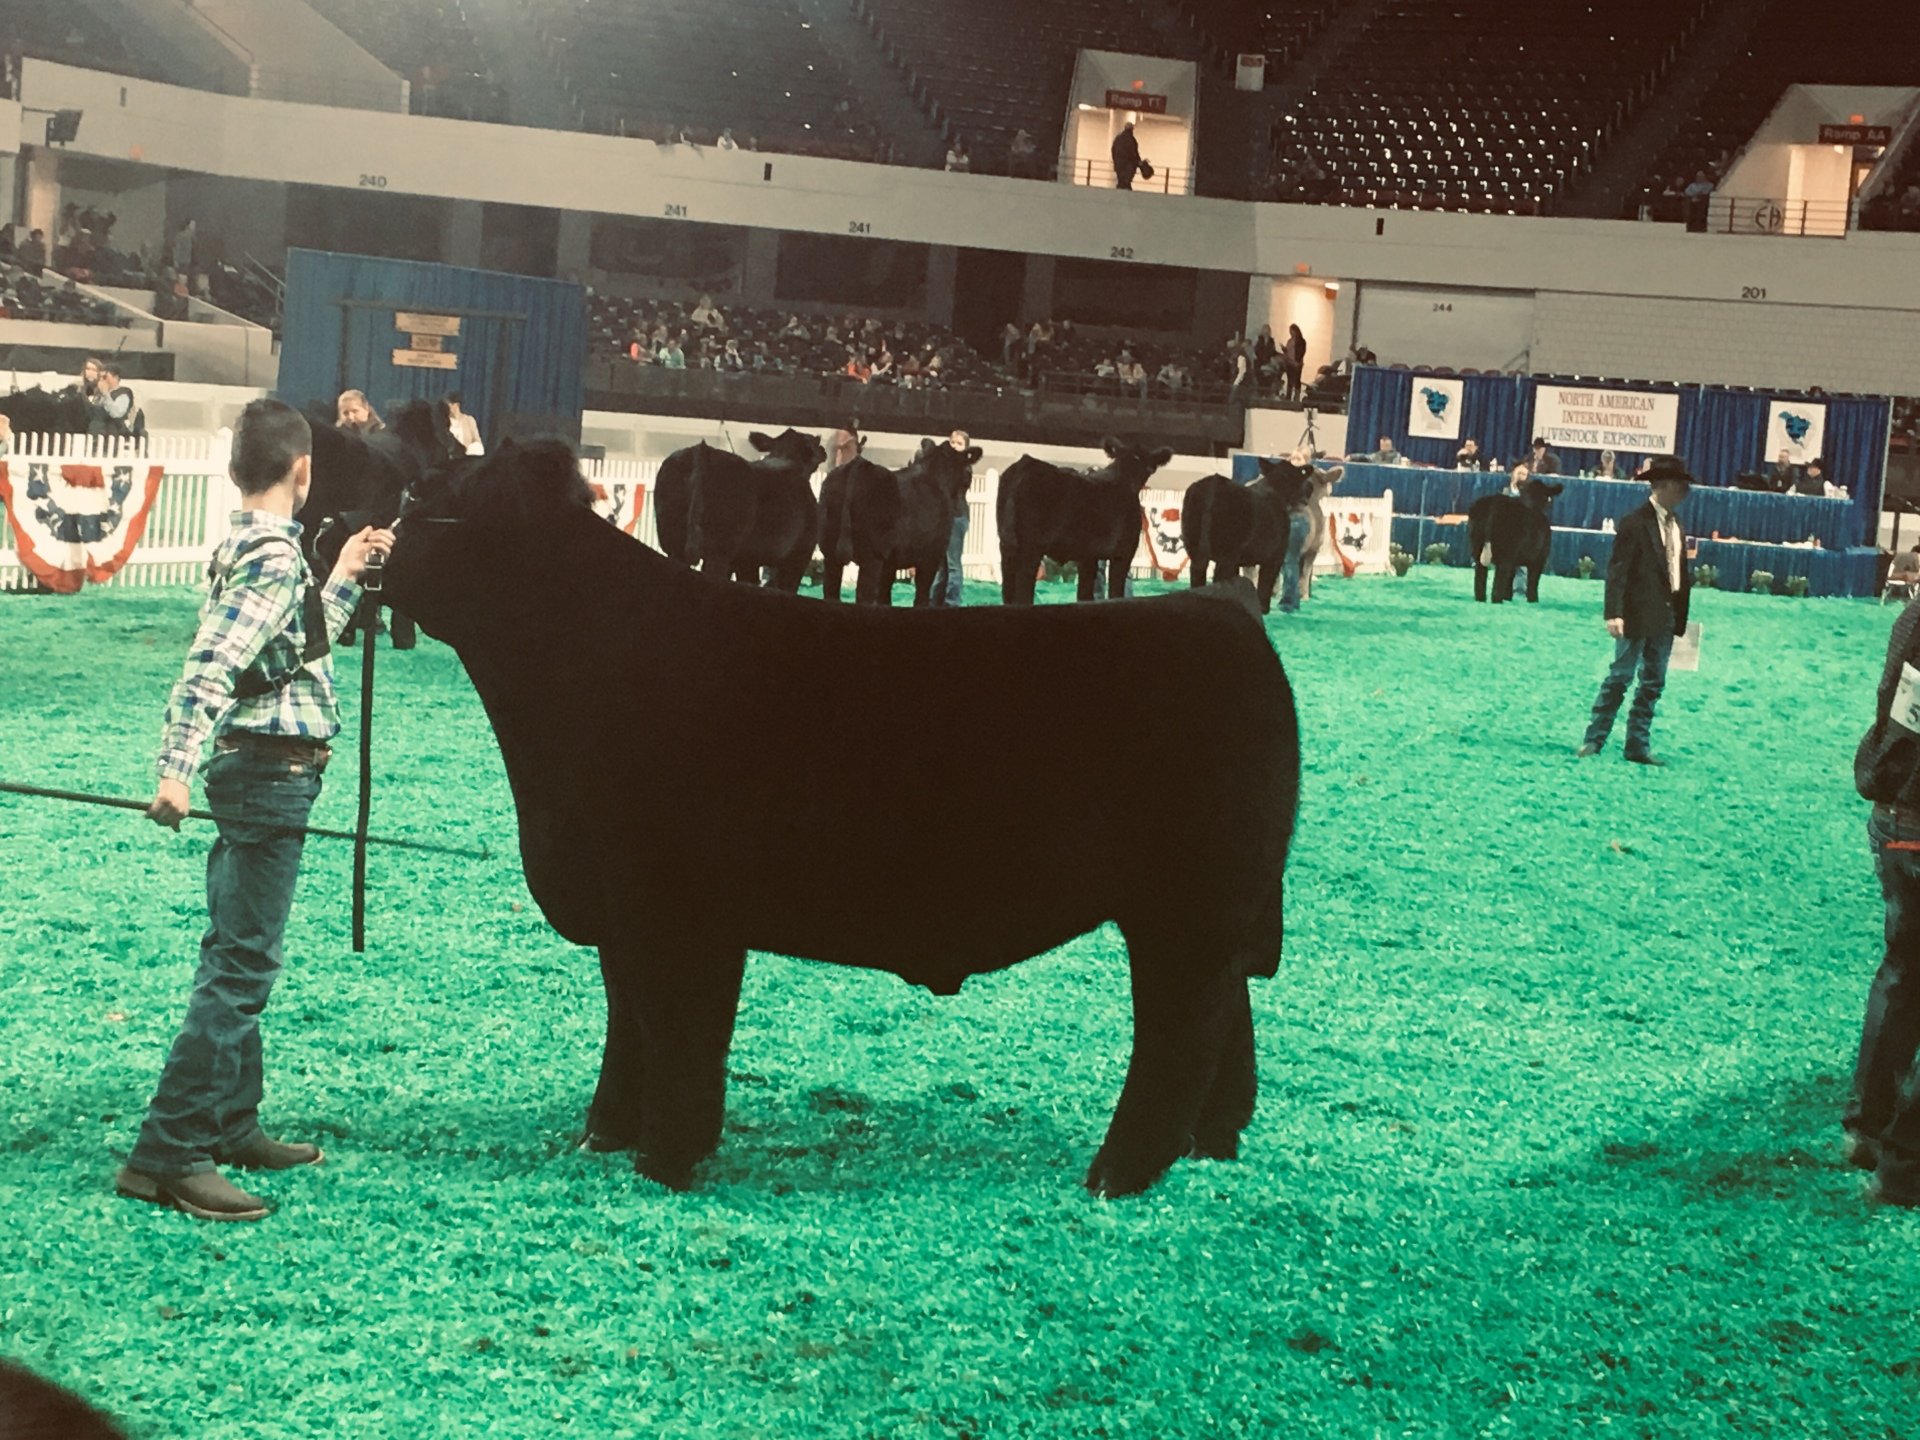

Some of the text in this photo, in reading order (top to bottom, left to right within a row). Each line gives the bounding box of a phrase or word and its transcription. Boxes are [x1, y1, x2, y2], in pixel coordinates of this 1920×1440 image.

[1111, 94, 1142, 107] Ramp
[1824, 128, 1885, 140] Ramp AA
[360, 175, 387, 187] 240
[664, 204, 688, 217] 241
[849, 221, 871, 233] 241
[1111, 246, 1134, 259] 242
[1742, 286, 1766, 299] 201
[1433, 303, 1452, 312] 244
[1558, 391, 1655, 411] NORTH AMERICAN
[1562, 409, 1647, 429] INTERNATIONAL
[1541, 427, 1667, 448] LIVESTOCK EXPOSITION
